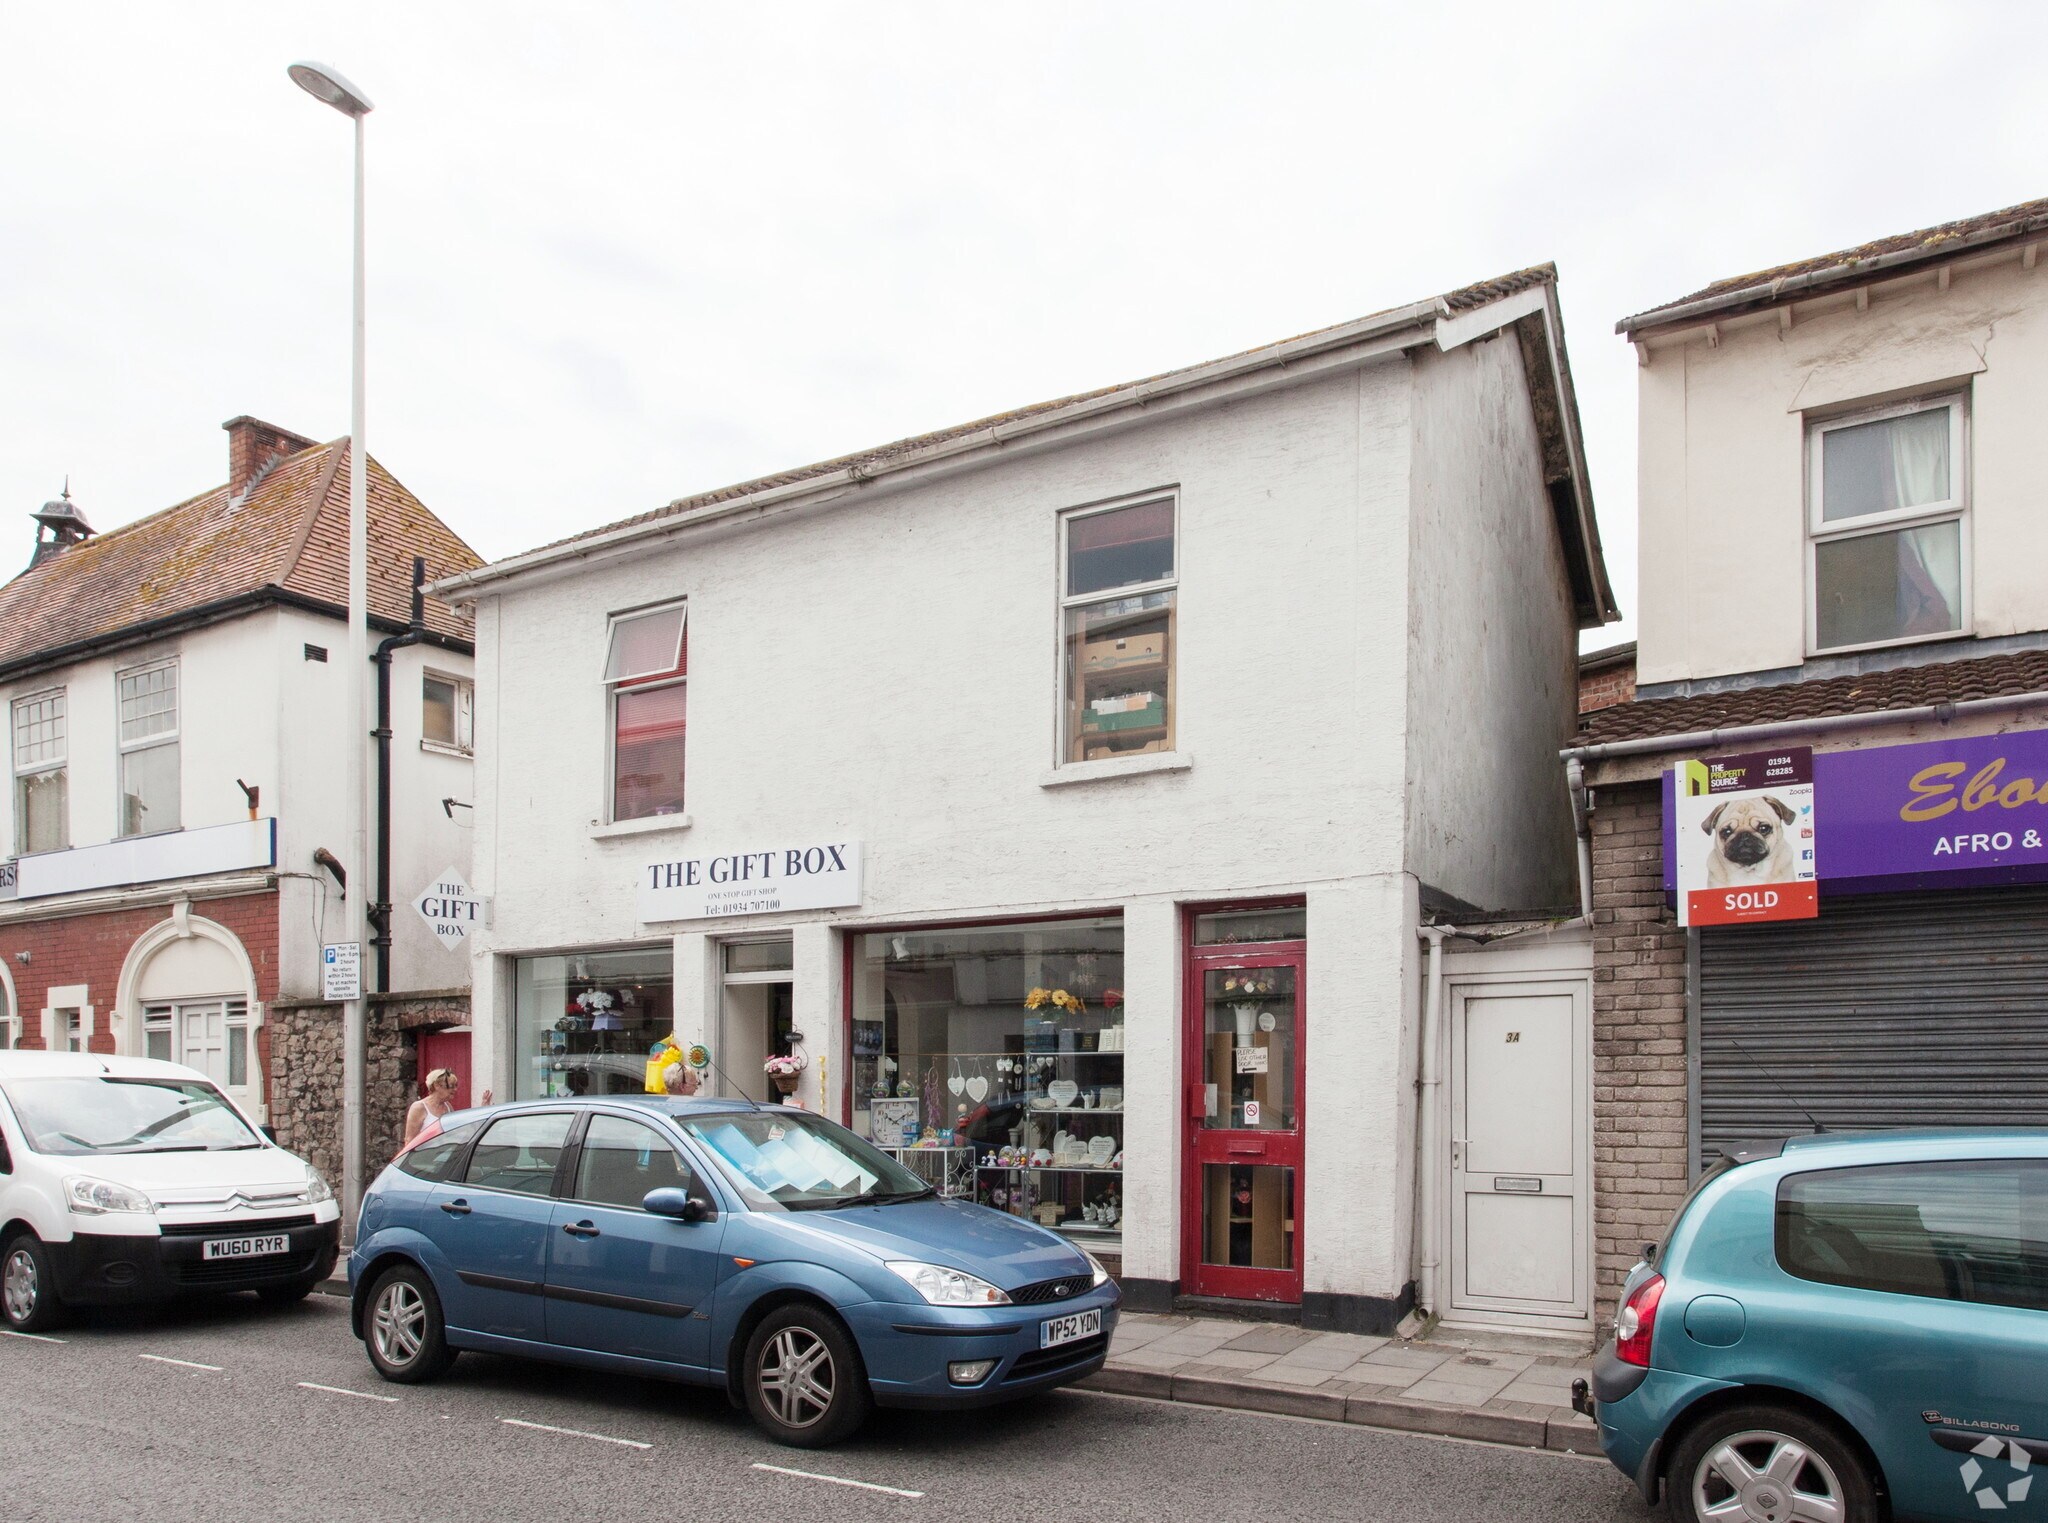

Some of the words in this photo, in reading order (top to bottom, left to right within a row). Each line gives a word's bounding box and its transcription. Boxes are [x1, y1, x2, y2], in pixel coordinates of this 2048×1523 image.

[1711, 764, 1724, 772] THE
[1768, 757, 1791, 766] 01934
[1711, 768, 1746, 779] PROPERTY
[1766, 767, 1794, 776] 628285
[1711, 777, 1738, 787] SOURCE
[1789, 788, 1812, 796] Zoopla
[1934, 832, 2012, 856] AFRO
[2022, 829, 2043, 848] &
[648, 860, 701, 889] THE
[710, 852, 776, 884] GIFT
[784, 844, 847, 876] BOX
[437, 883, 464, 896] THE
[708, 892, 721, 900] ONE
[723, 891, 740, 899] STOP
[741, 889, 757, 897] GIFT
[759, 887, 777, 896] SHOP
[704, 904, 721, 915] Tel:
[723, 902, 748, 914] 01934
[750, 899, 780, 912] 707100
[1725, 891, 1778, 910] SOLD
[422, 897, 479, 920] GIFT
[437, 924, 464, 936] BOX
[1506, 1032, 1520, 1043] 3A
[211, 1240, 251, 1256] WU60
[255, 1237, 283, 1252] RYR
[1049, 1317, 1077, 1342] WP52
[1080, 1311, 1099, 1333] YDN
[1943, 1417, 2020, 1431] BILLABONG
